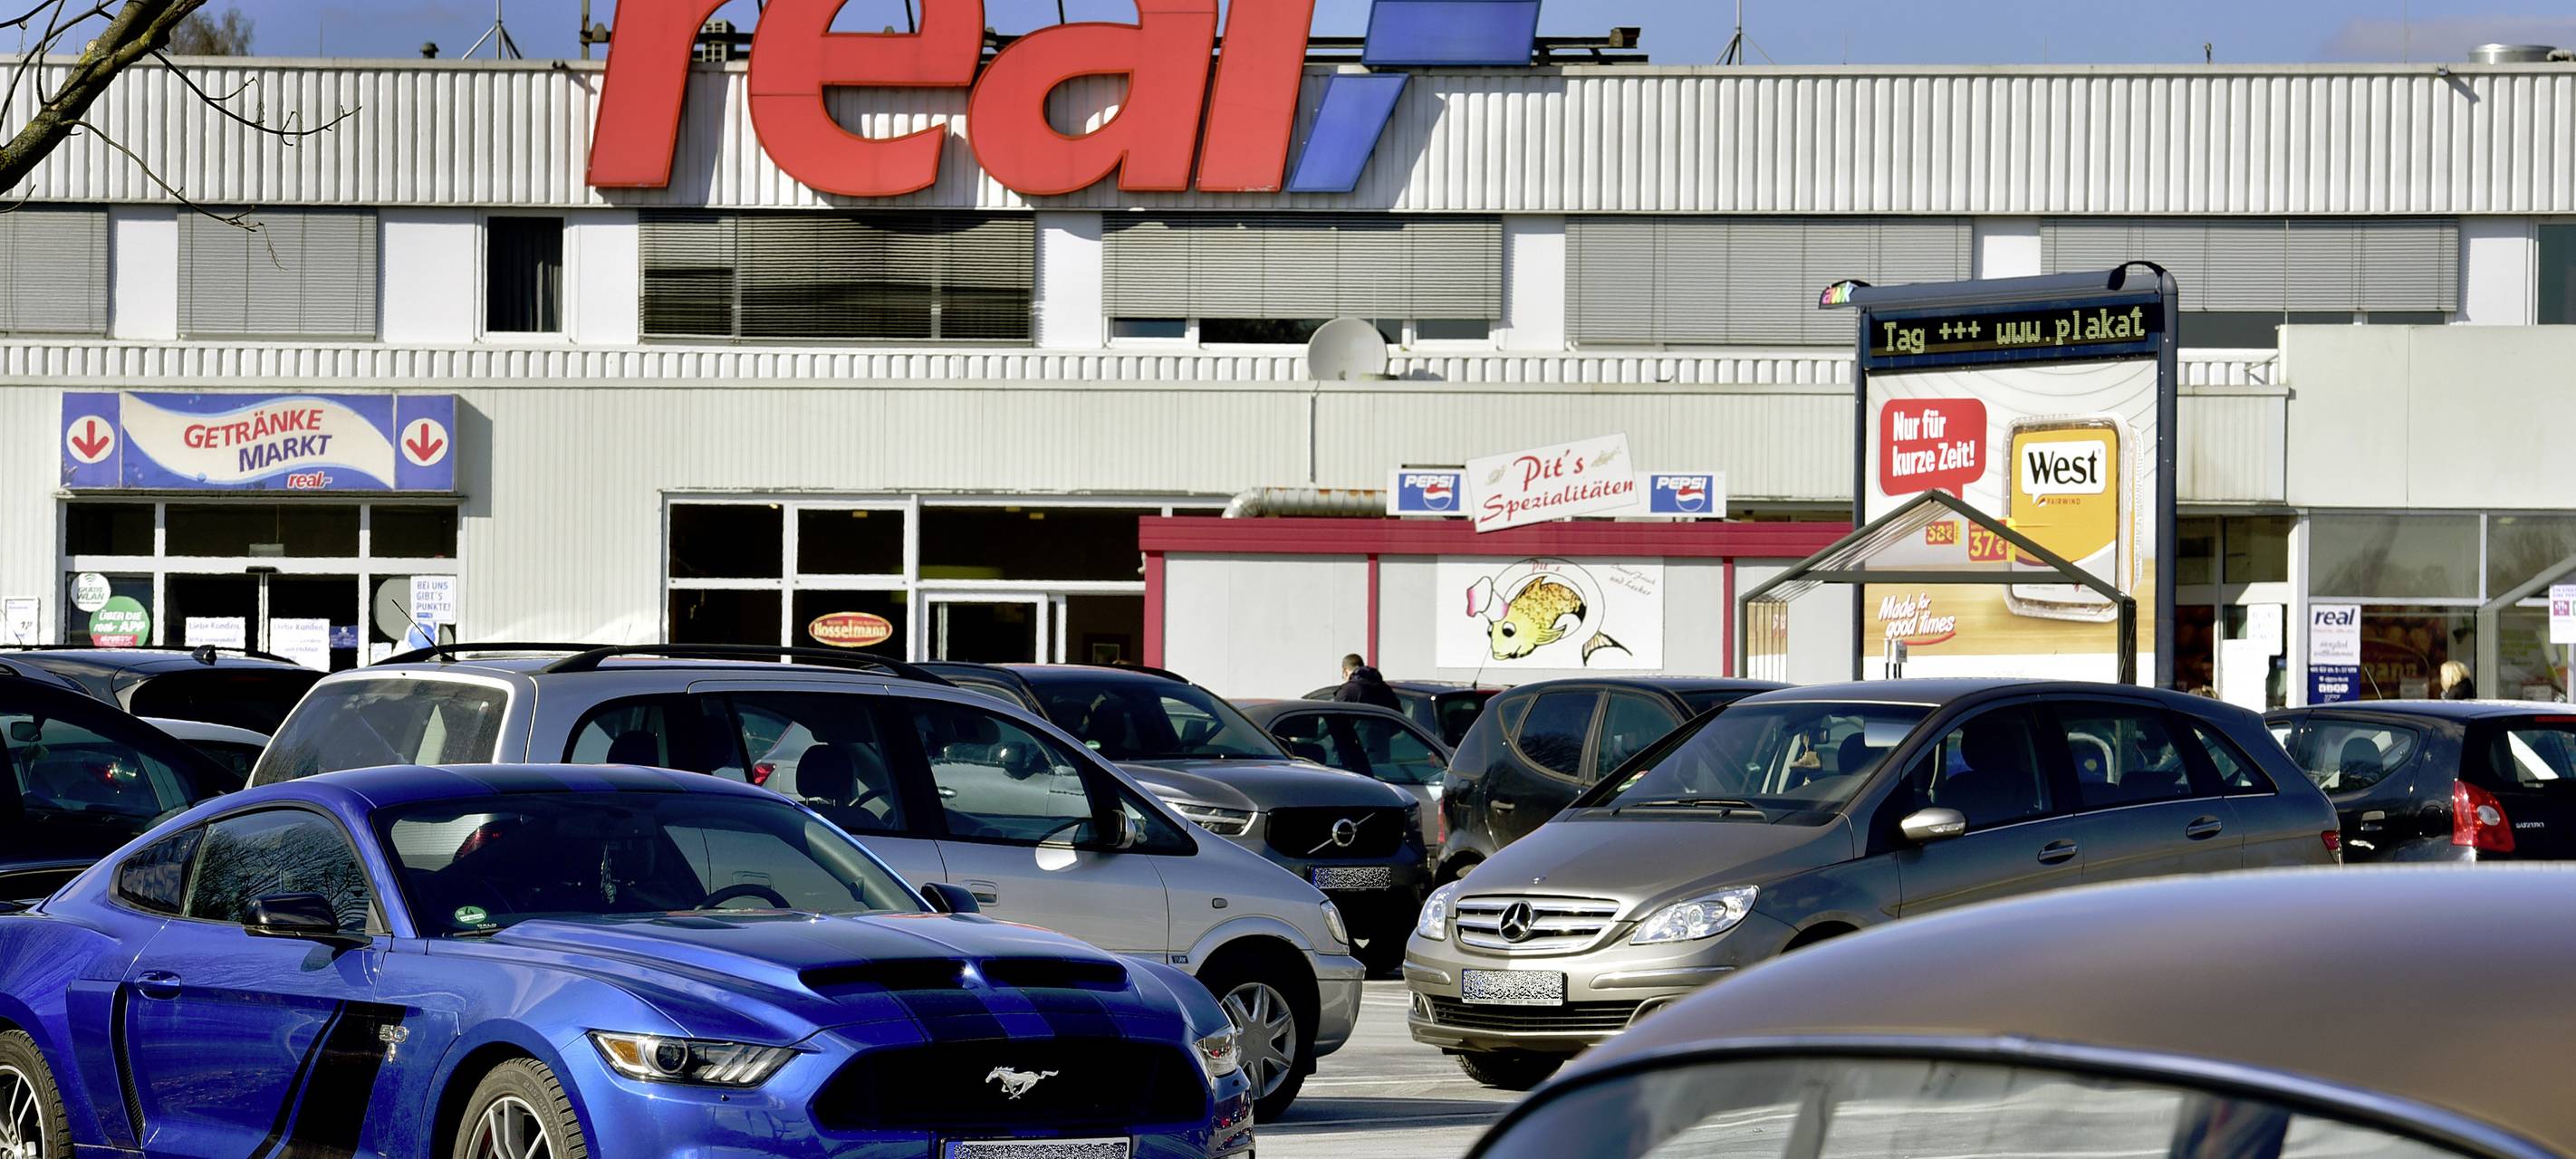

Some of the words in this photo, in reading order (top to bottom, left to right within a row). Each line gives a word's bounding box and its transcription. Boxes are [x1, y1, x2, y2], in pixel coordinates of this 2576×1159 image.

[1883, 321, 1926, 354] Tag
[184, 409, 324, 449] GETRÄNKE
[1892, 410, 1920, 442] Nur
[1921, 408, 1946, 439] für
[238, 435, 333, 473] MARKT
[1514, 449, 1584, 492] Pit's
[1891, 445, 1936, 477] kurze
[1937, 439, 1975, 471] Zeit!
[2028, 450, 2097, 484] West
[1404, 474, 1456, 488] PEPSI
[1656, 477, 1707, 490] PEPSI
[1479, 480, 1634, 522] Spezialitäten
[417, 580, 429, 589] BEI
[432, 581, 448, 590] UNS
[1878, 593, 1916, 621] Made
[1917, 591, 1931, 610] for
[2314, 608, 2355, 626] real
[119, 621, 146, 632] APP
[1885, 610, 1919, 640] good
